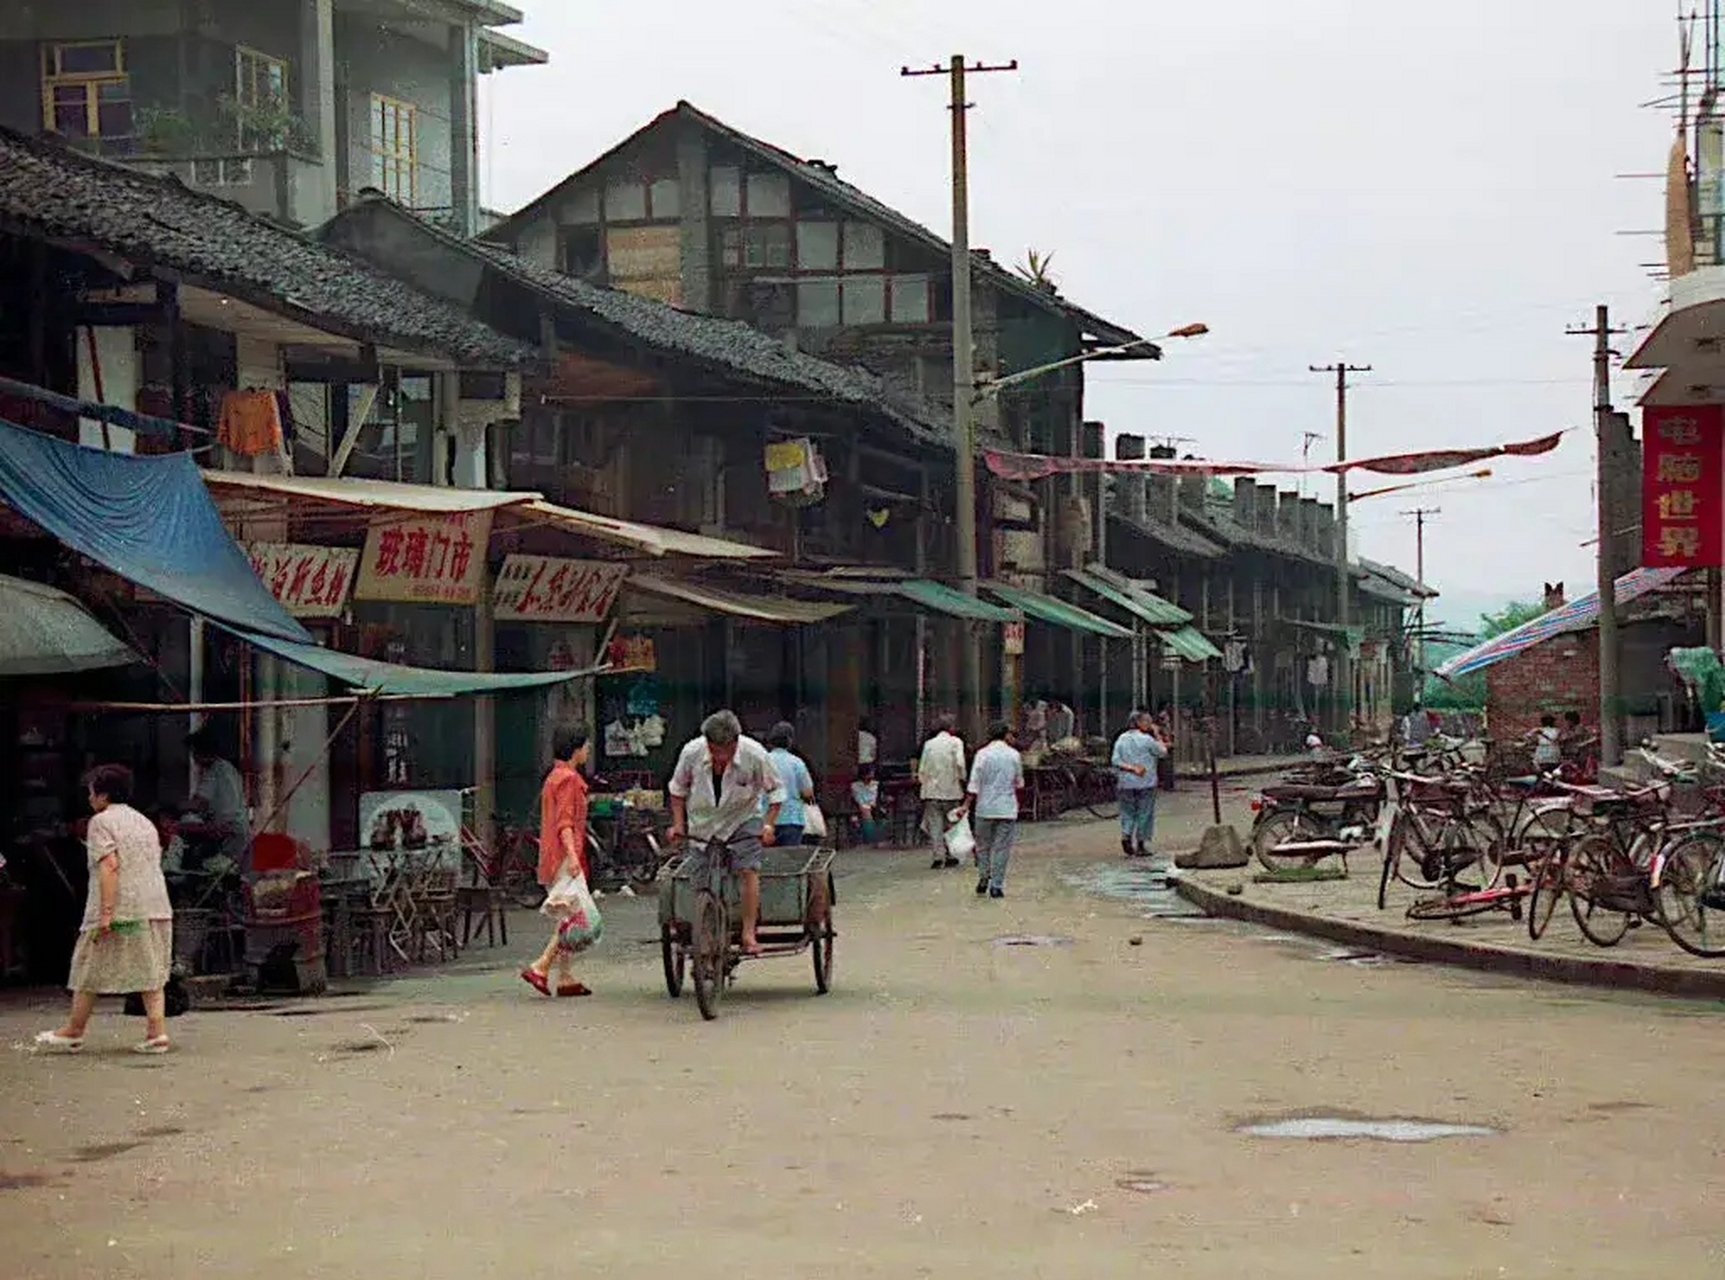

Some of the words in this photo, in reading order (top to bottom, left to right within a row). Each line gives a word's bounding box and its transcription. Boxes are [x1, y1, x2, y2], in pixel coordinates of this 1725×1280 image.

[1655, 417, 1702, 558] 电脑世界
[375, 525, 474, 582] 玻璃门市
